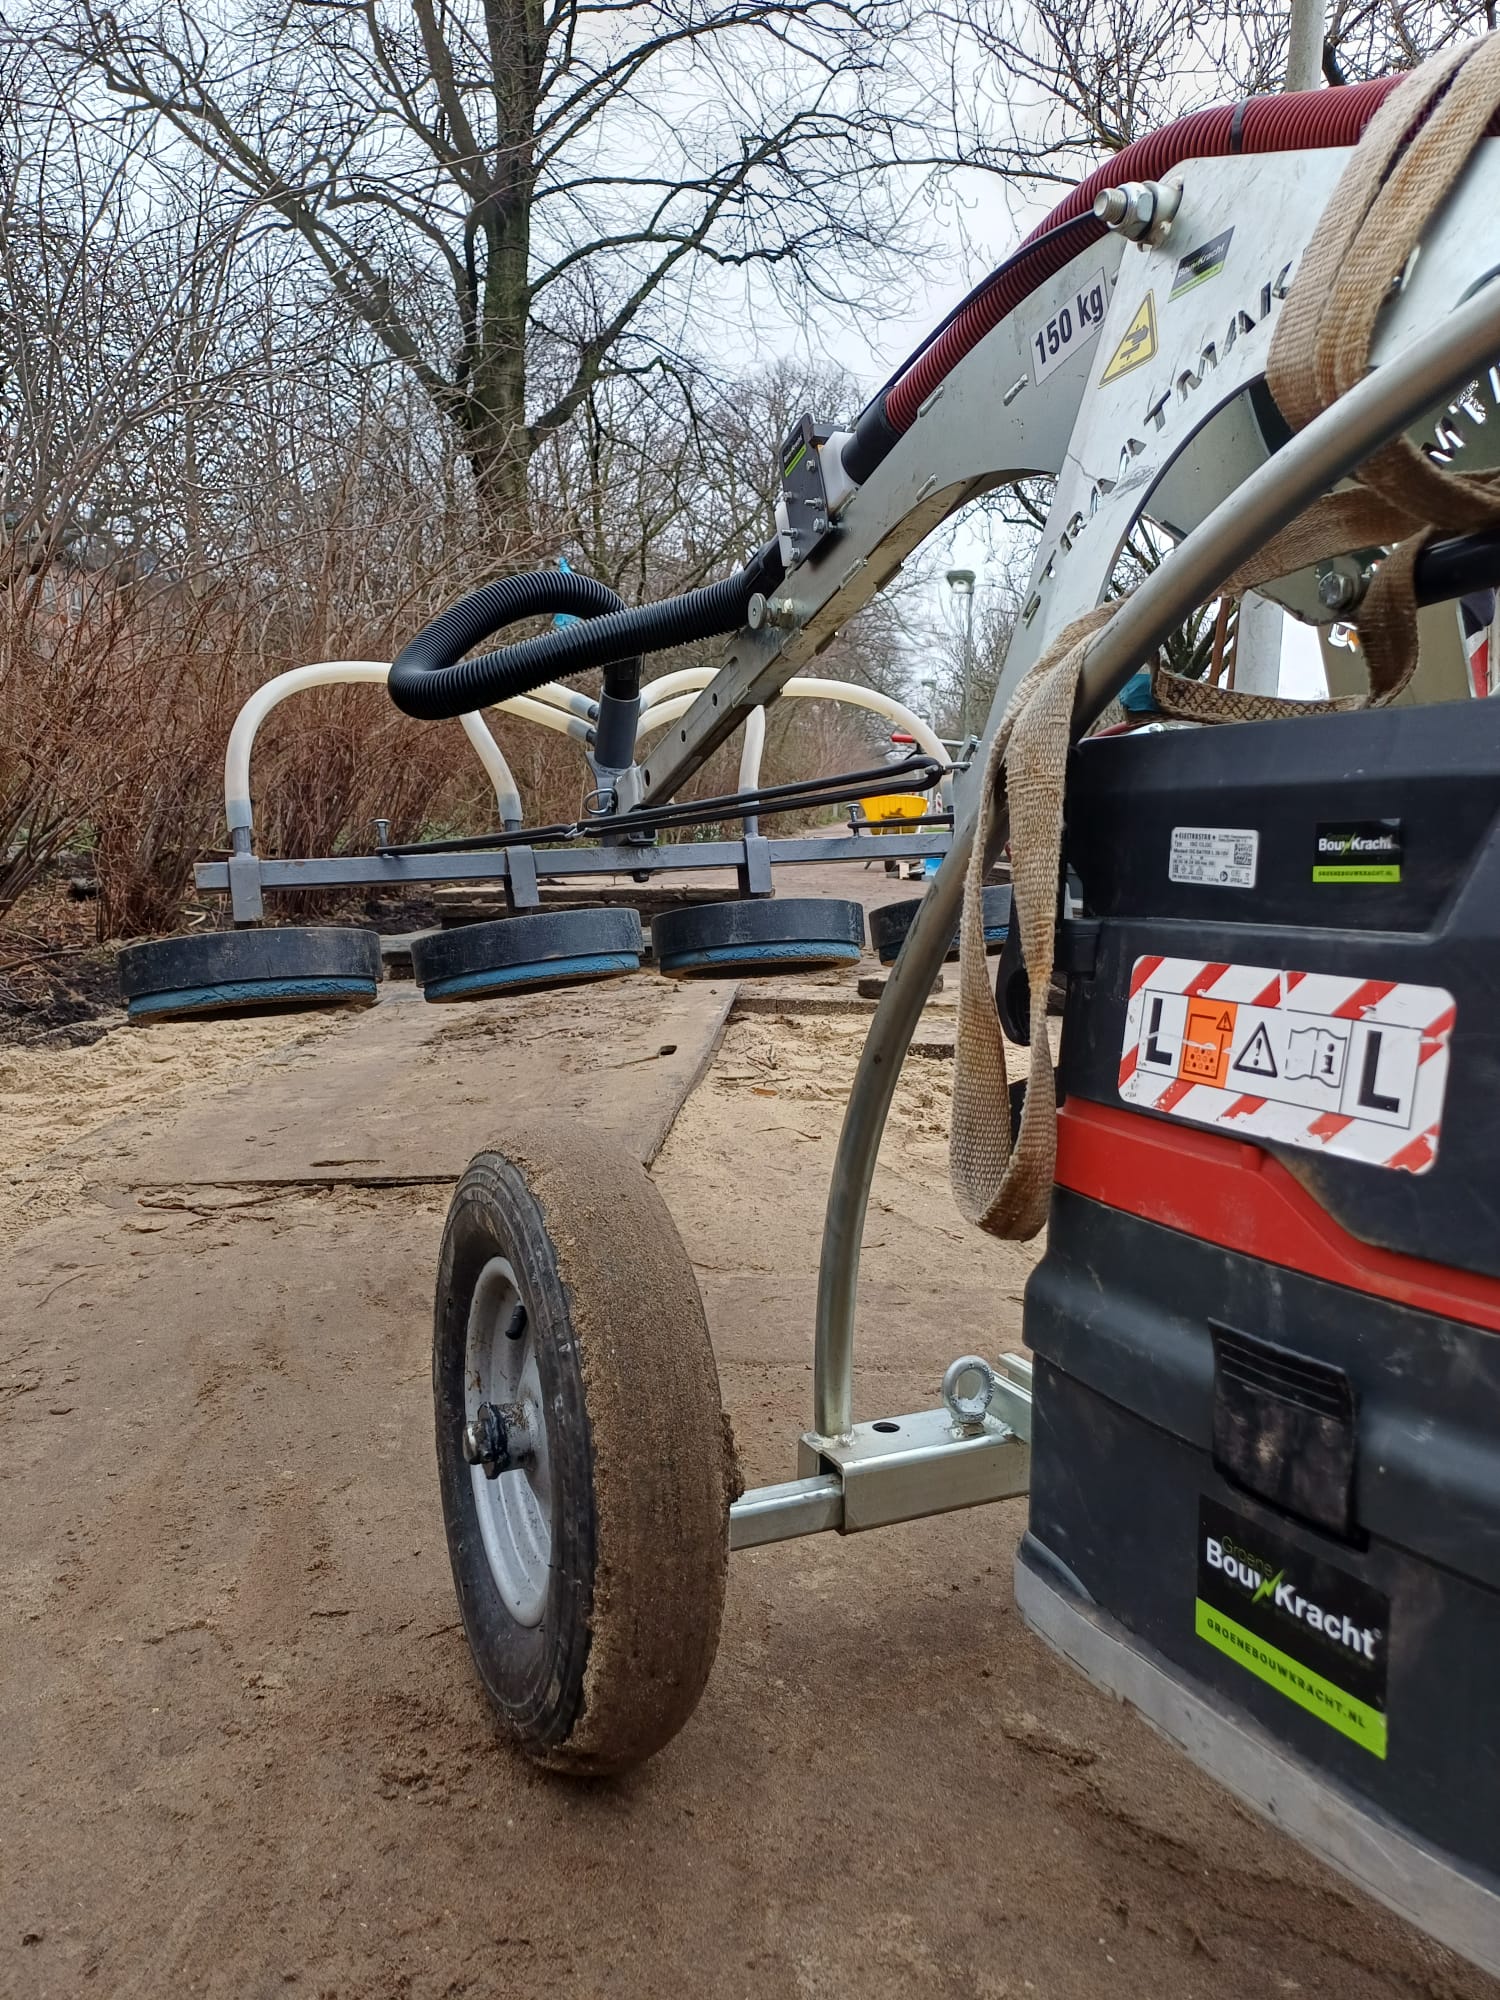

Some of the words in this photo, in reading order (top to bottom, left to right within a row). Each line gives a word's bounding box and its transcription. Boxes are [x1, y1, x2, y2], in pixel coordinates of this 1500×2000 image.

[1035, 308, 1073, 365] 150
[1077, 284, 1104, 330] kg
[1145, 997, 1173, 1066] L
[1357, 1029, 1401, 1113] L
[1206, 1617, 1367, 1729] GROENEBOUWKRACHT.NL
